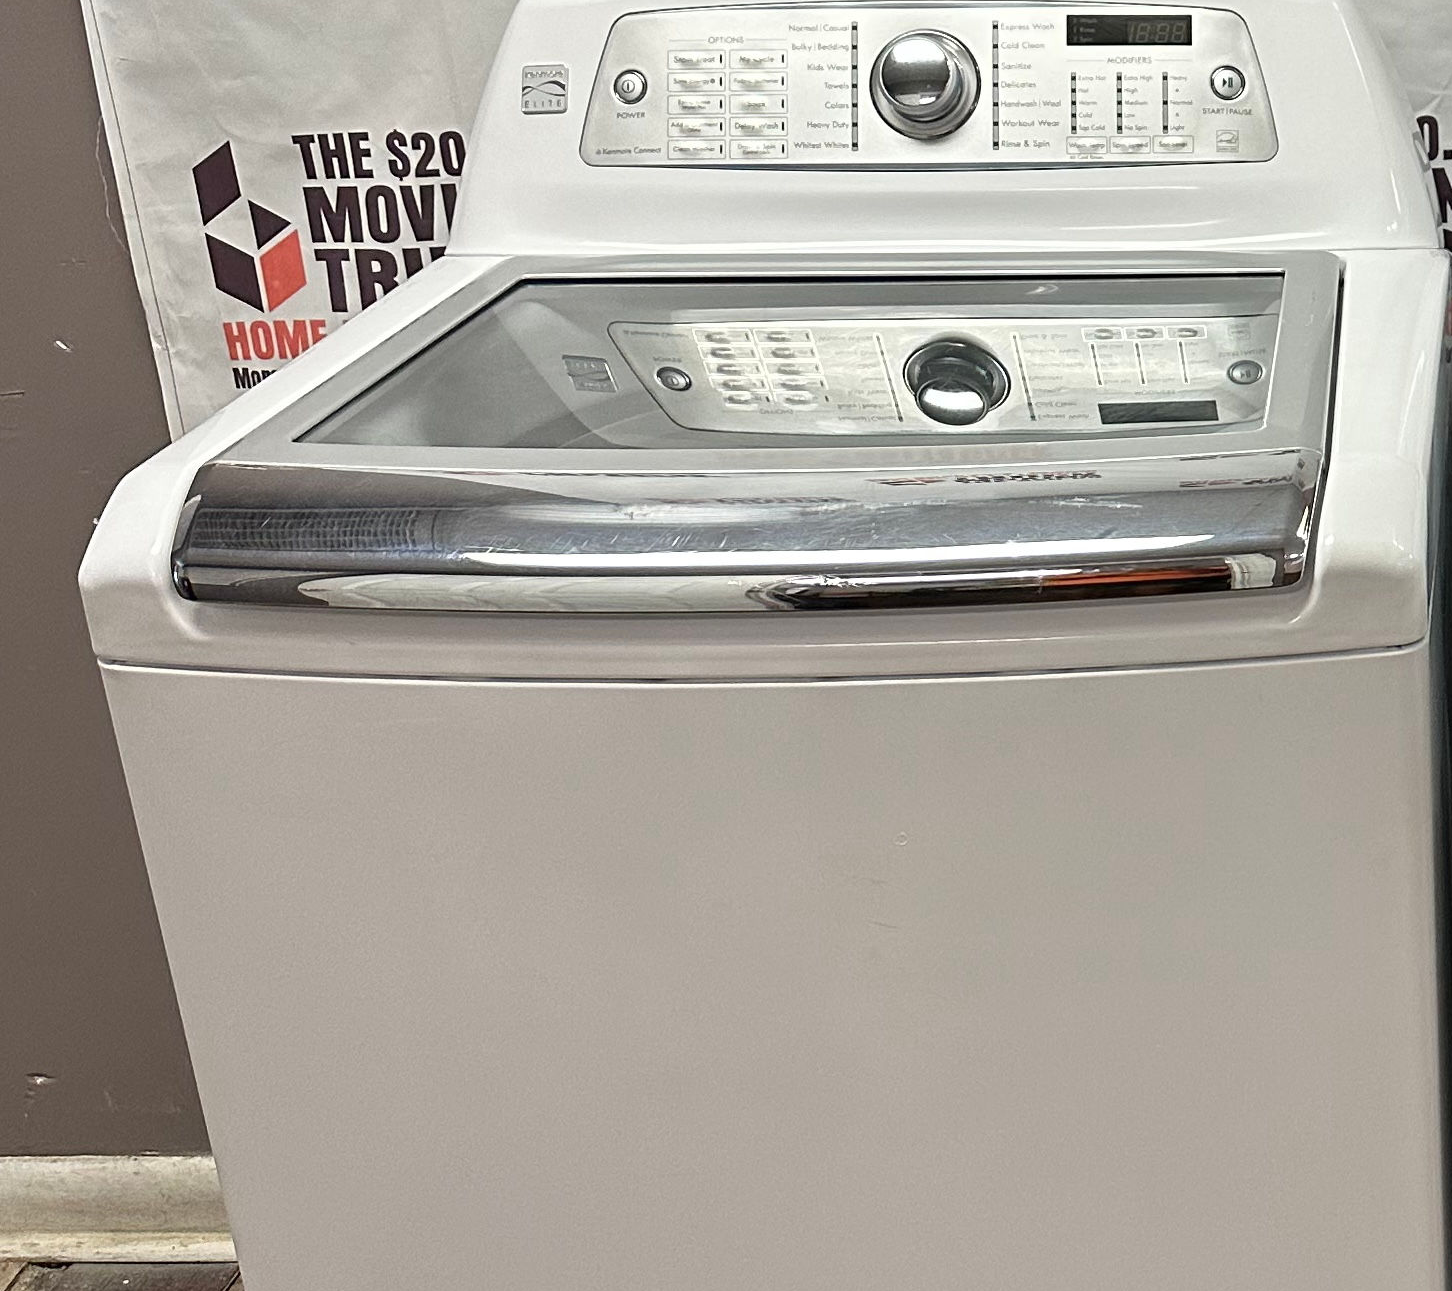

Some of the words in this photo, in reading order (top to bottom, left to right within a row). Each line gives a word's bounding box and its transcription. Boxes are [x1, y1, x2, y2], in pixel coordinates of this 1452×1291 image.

[708, 36, 744, 44] OPTIONS
[616, 111, 646, 119] POWER
[291, 132, 374, 179] THE
